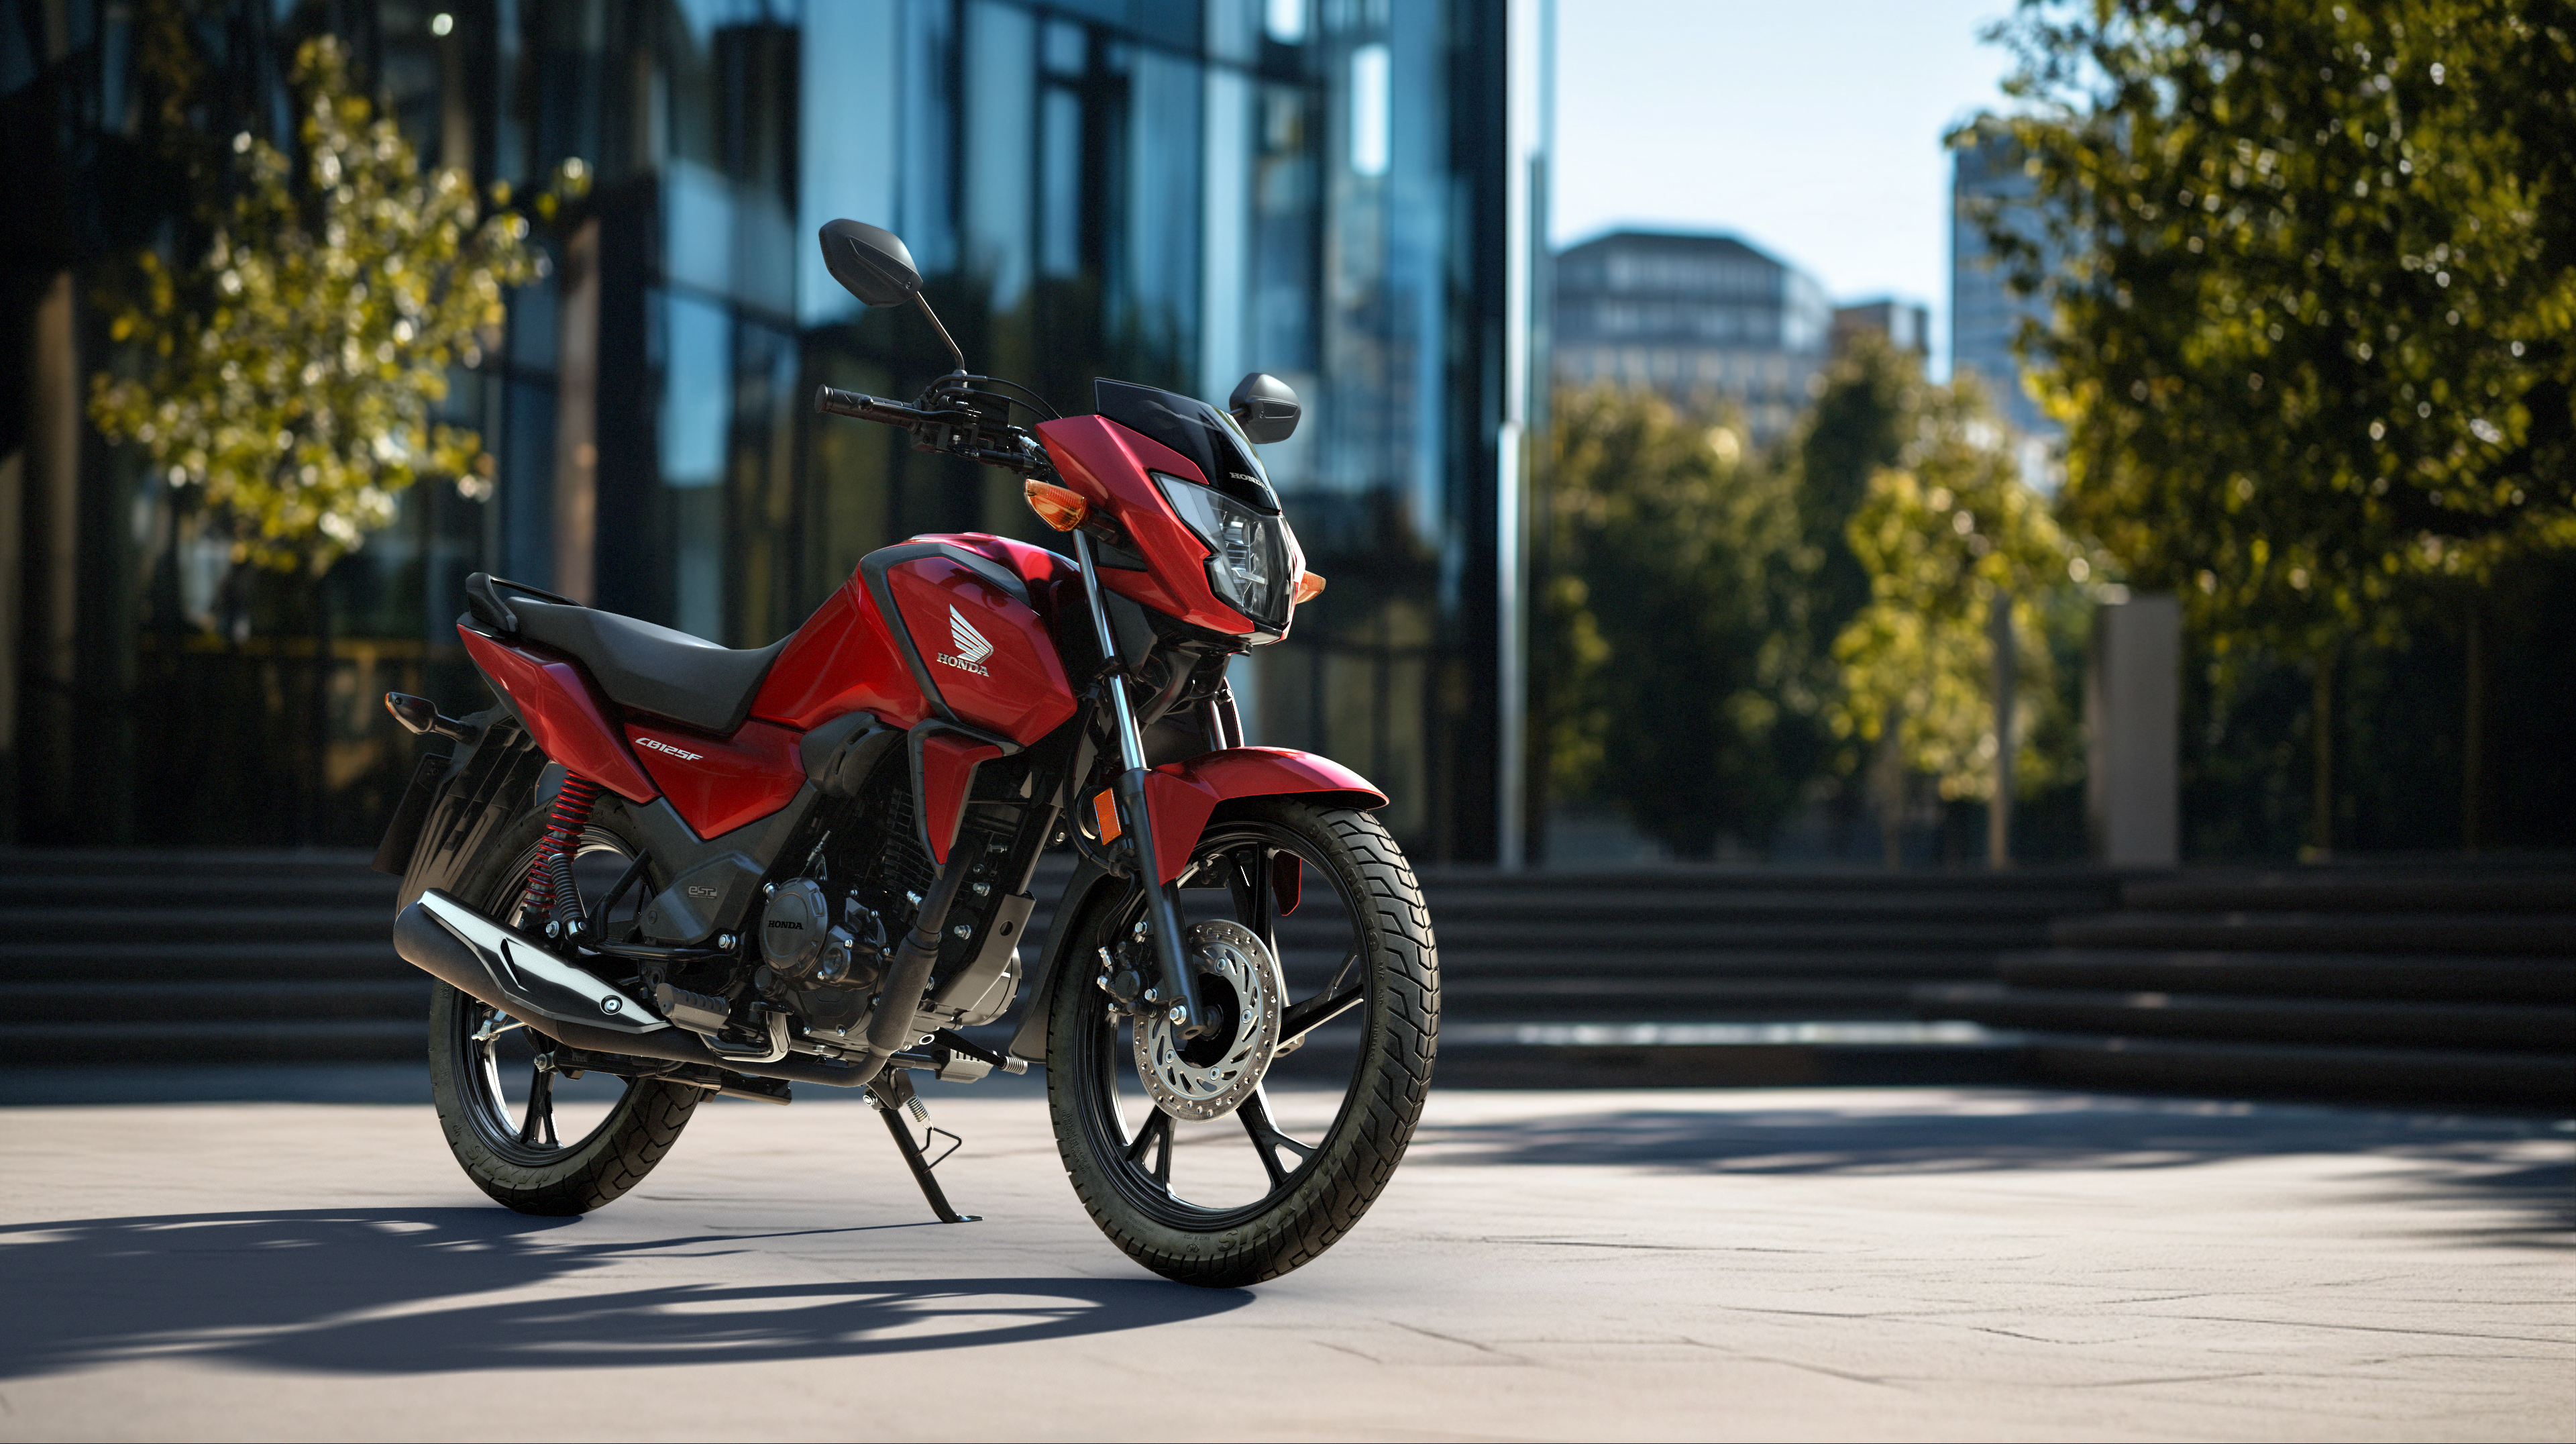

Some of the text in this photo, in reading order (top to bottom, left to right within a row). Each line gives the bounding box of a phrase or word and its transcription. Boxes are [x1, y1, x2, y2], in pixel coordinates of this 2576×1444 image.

[1229, 472, 1269, 491] HONDA
[936, 652, 989, 677] HONDA
[635, 737, 704, 760] CB125F
[767, 920, 804, 930] HONDA
[465, 1142, 557, 1184] MAXXIS
[1218, 1140, 1338, 1252] MAXXIS
